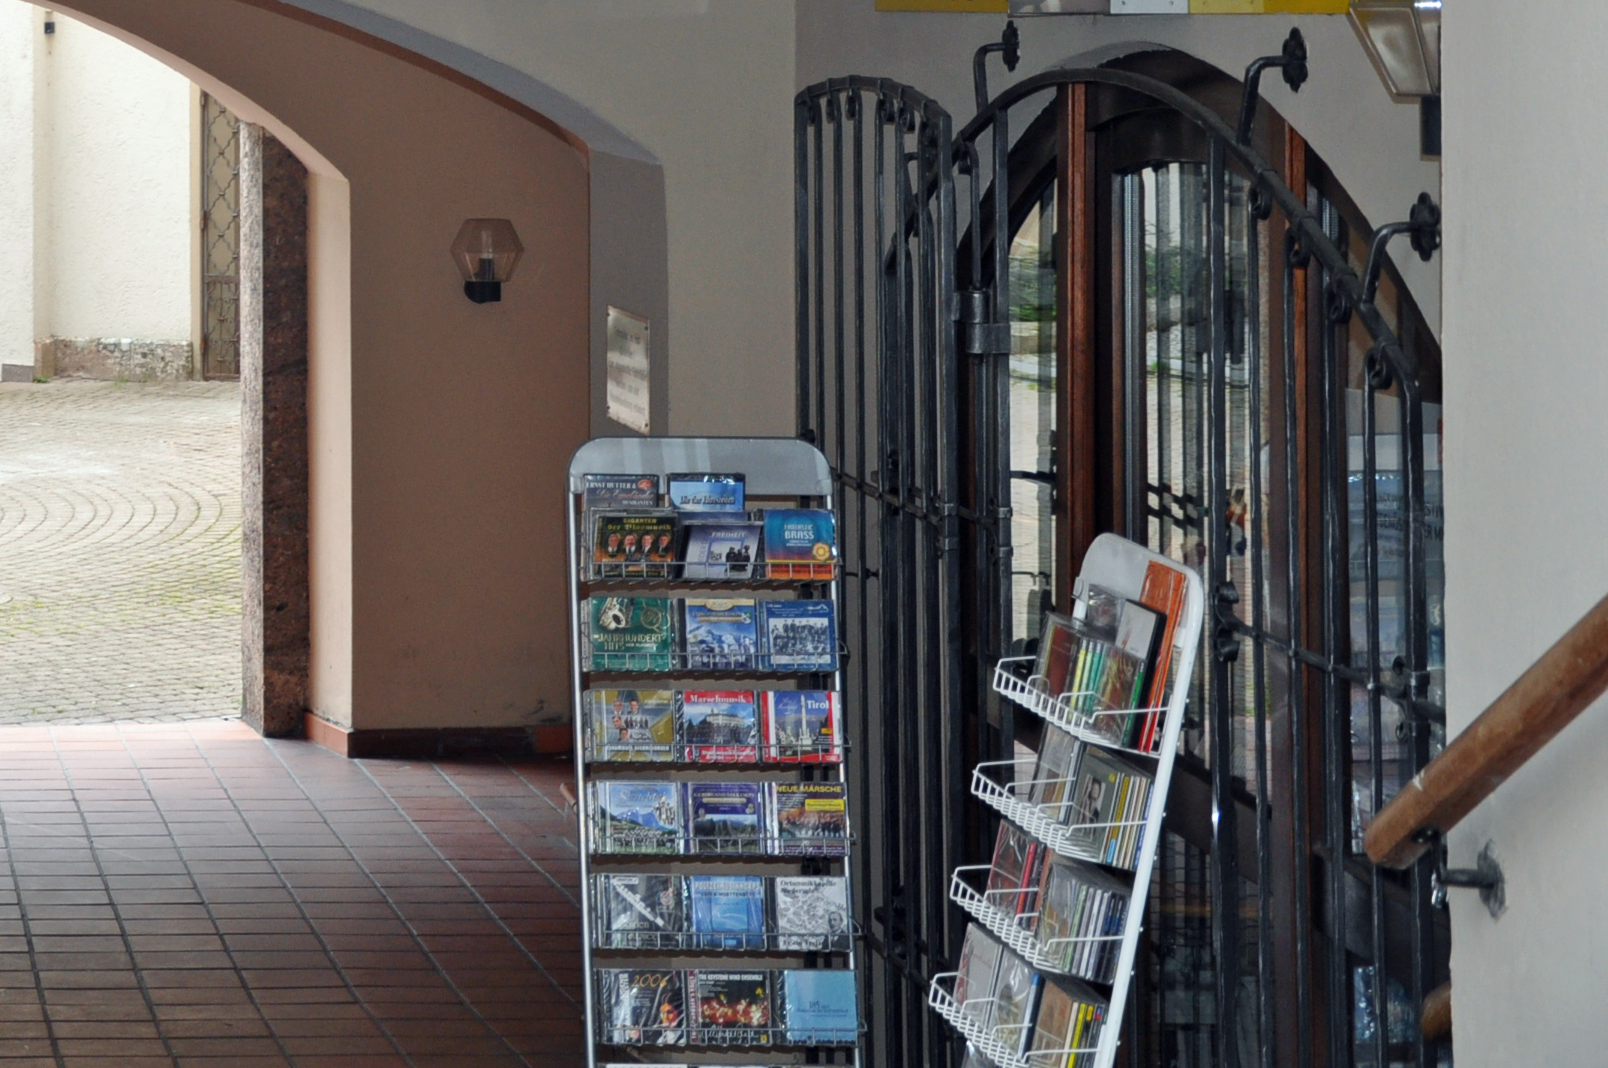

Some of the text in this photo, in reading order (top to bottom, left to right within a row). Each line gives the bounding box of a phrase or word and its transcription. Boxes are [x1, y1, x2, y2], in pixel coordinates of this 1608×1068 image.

[785, 530, 814, 539] BRASS
[689, 695, 747, 704] Marschmusik
[806, 700, 829, 710] Tirol
[776, 785, 798, 793] NEUE
